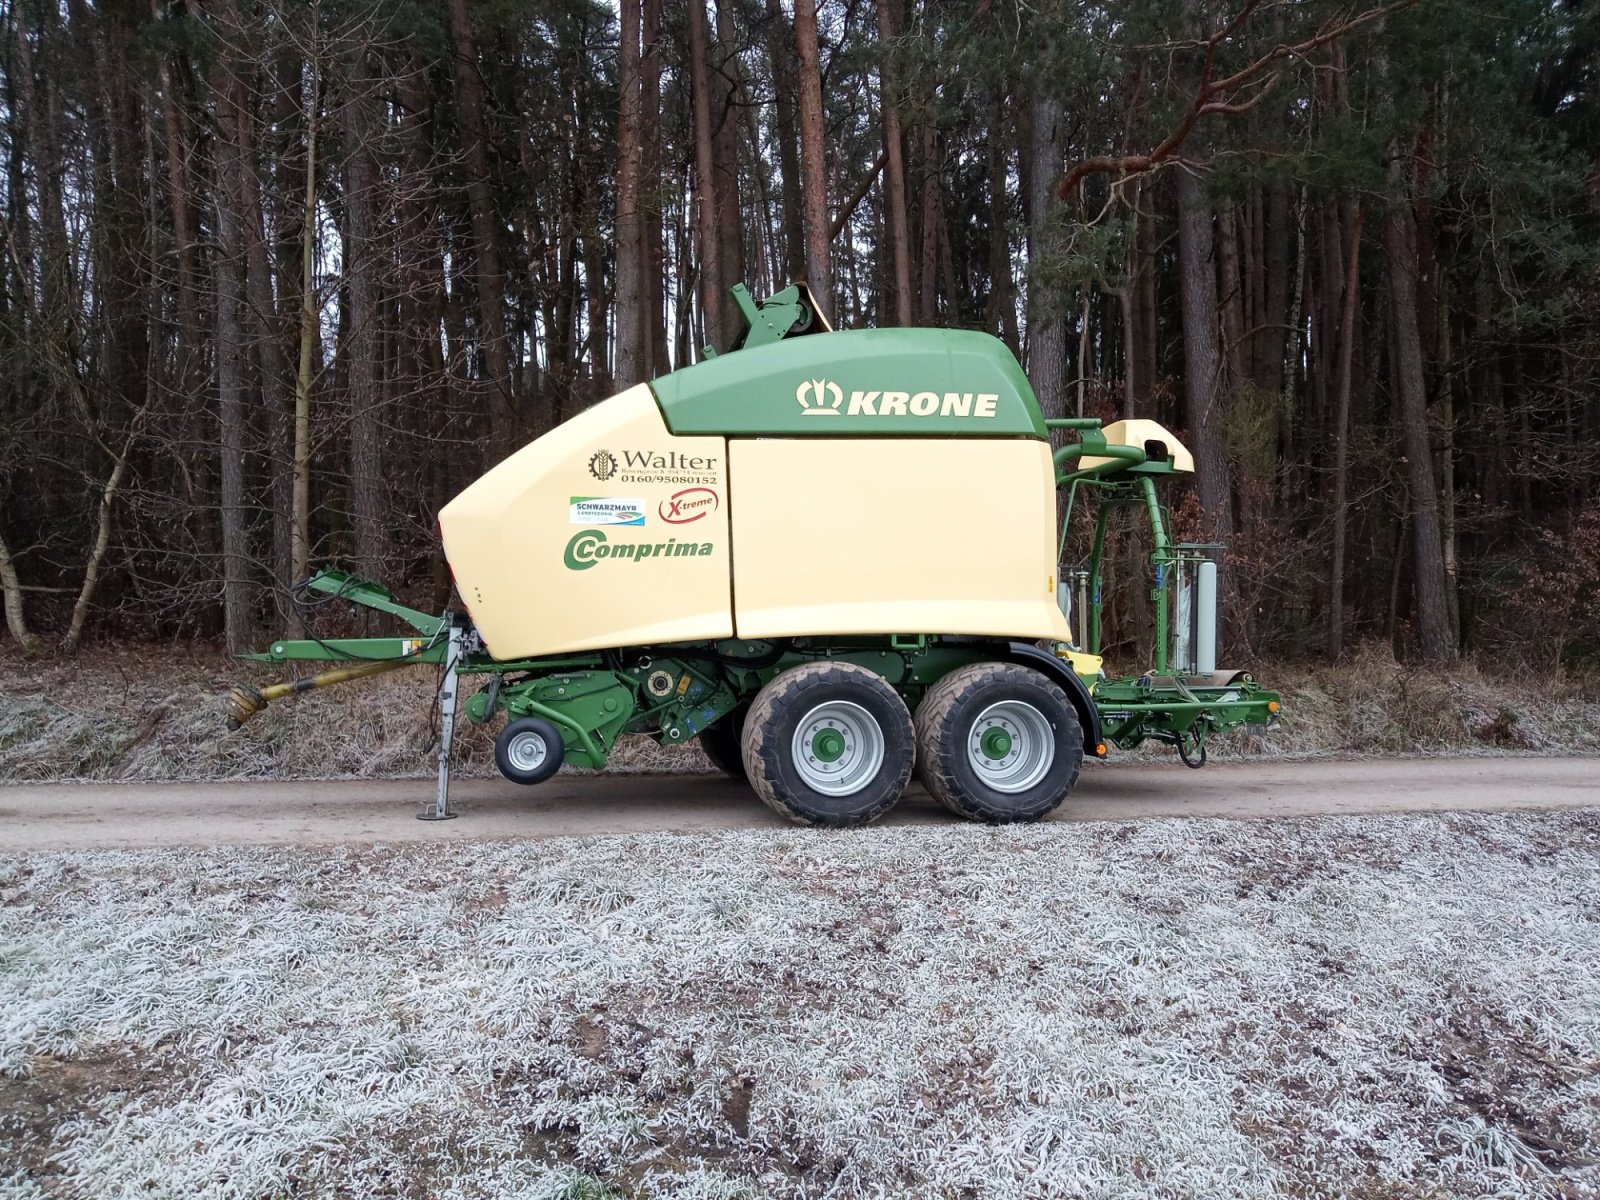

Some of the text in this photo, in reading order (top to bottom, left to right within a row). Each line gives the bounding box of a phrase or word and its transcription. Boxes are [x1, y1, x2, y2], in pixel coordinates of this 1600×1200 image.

[847, 391, 999, 418] KRONE
[621, 450, 718, 470] Walter
[621, 475, 718, 485] 0160/95080152
[576, 503, 637, 512] SCHWARZMAYR
